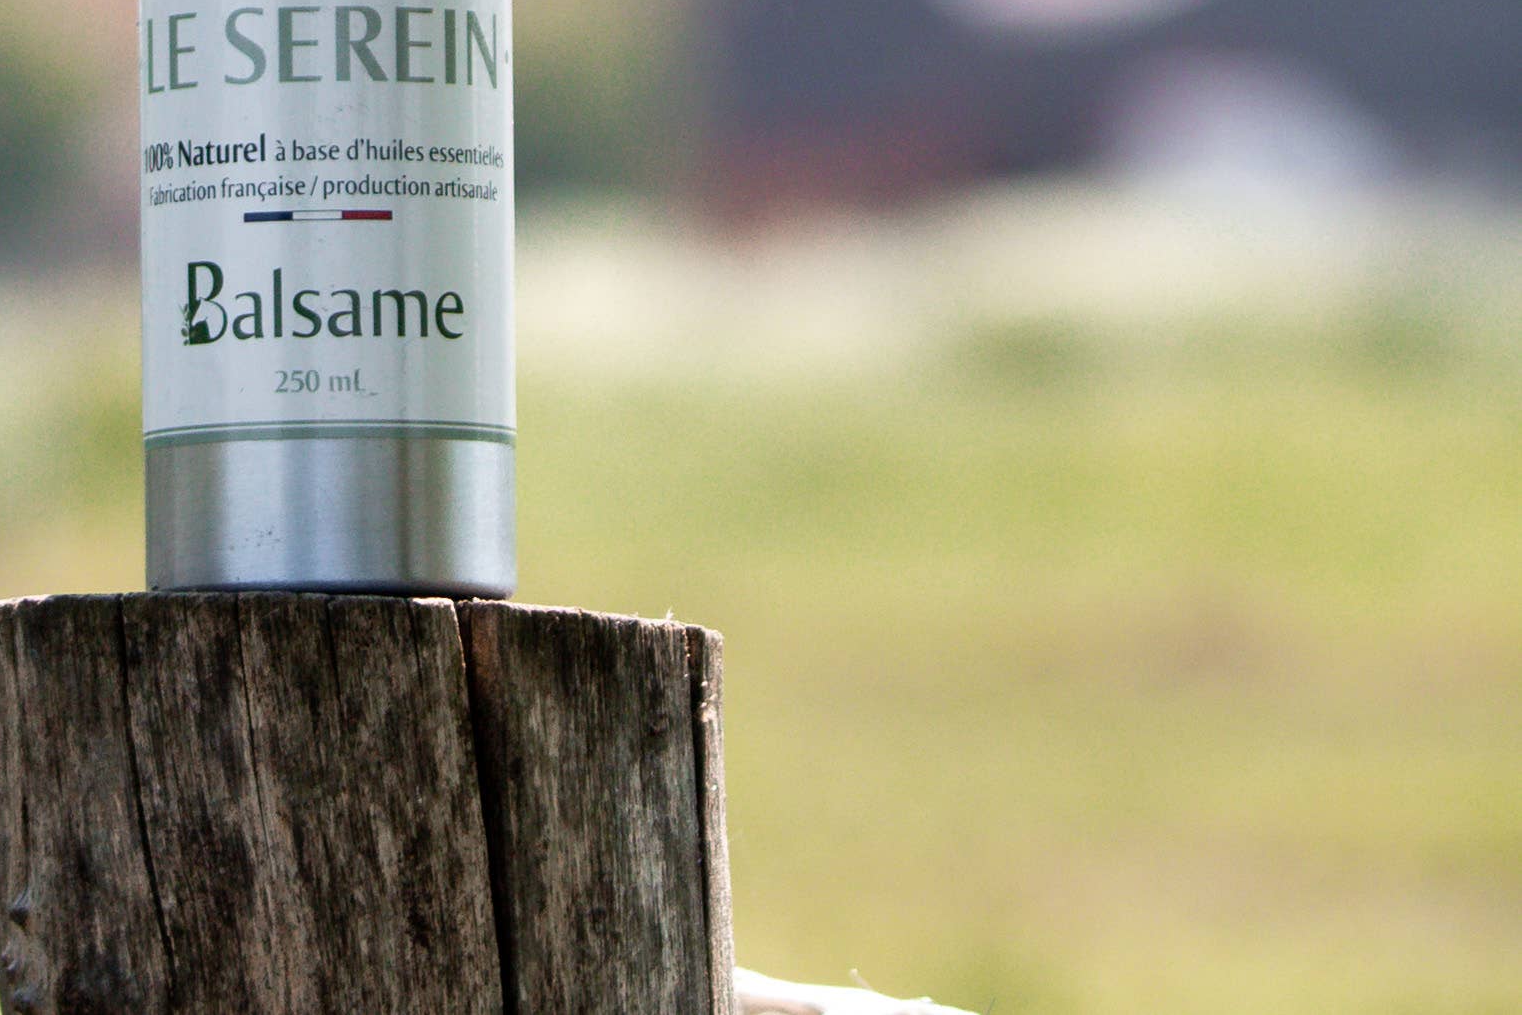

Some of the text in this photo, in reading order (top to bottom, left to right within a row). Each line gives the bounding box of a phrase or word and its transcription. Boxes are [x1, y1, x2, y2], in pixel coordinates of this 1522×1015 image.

[146, 6, 498, 94] LE SEREIN
[144, 133, 504, 174] 100% Naturel à base d'huiles essentielles
[150, 174, 498, 206] Fabrication française / production artisanale
[181, 260, 465, 346] Balsame
[274, 369, 319, 394] 250
